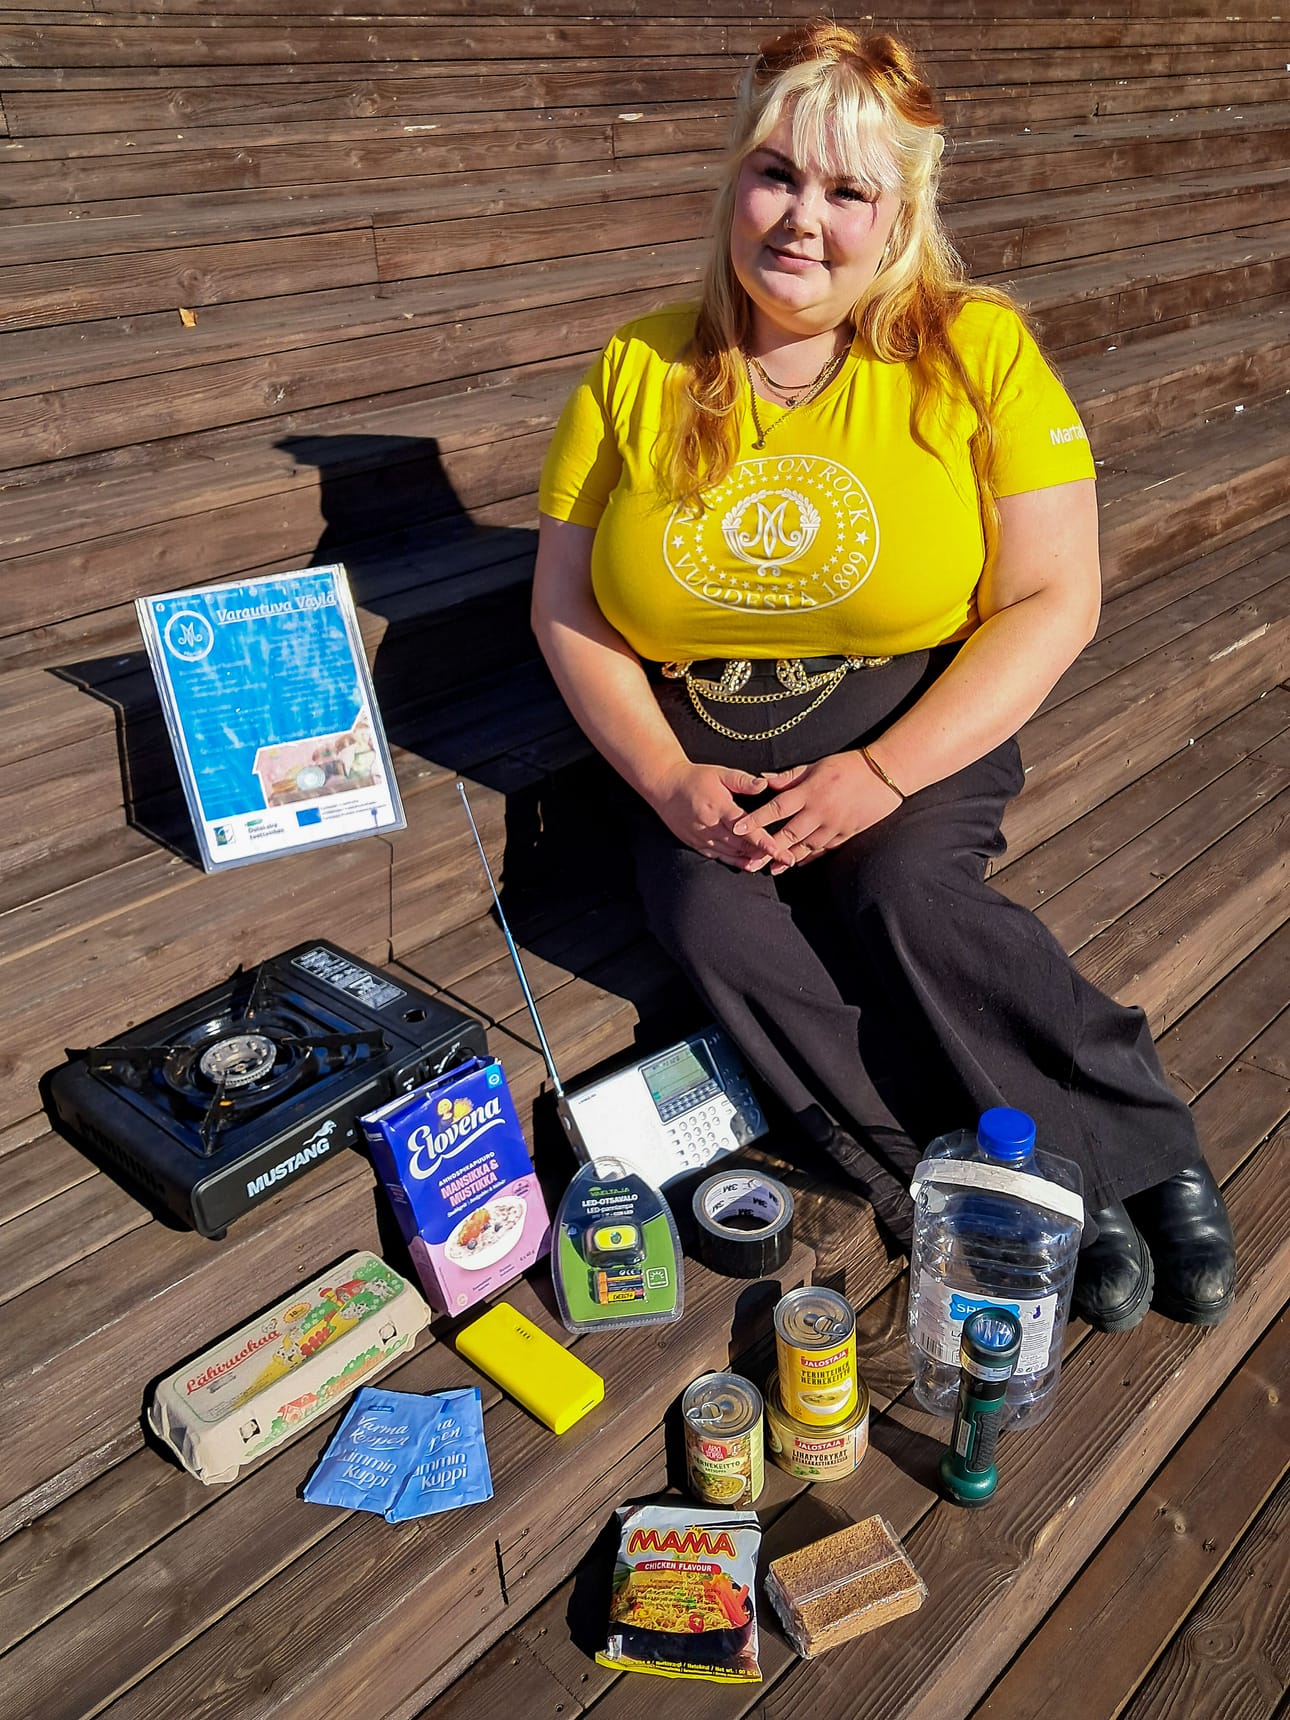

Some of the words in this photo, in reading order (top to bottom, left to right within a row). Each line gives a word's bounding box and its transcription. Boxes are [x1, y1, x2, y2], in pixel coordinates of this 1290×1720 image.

[777, 458, 817, 473] ON
[819, 464, 871, 527] ROCK
[675, 552, 819, 609] VUODESTA
[822, 551, 868, 599] 1899
[216, 601, 293, 622] Varautuva
[407, 1097, 502, 1180] Elovena
[247, 1138, 330, 1198] MUSTANG
[440, 1163, 491, 1199] MANSIKKA
[489, 1159, 499, 1170] &
[449, 1171, 498, 1207] MUSTIKKA
[723, 1183, 738, 1193] 3M
[186, 1330, 281, 1395] Lähiruokaa
[801, 1361, 849, 1378] PERINTEINEN
[804, 1351, 847, 1368] JALOSTAJA
[801, 1367, 850, 1385] HERNEKEITTO
[357, 1416, 409, 1434] Varma
[798, 1440, 841, 1451] JALOSTAJA
[343, 1464, 390, 1489] Kuppi
[421, 1465, 468, 1490] Kuppi
[628, 1528, 737, 1559] MAMA
[645, 1562, 676, 1570] CHICKEN
[679, 1562, 712, 1572] FLAVOUR
